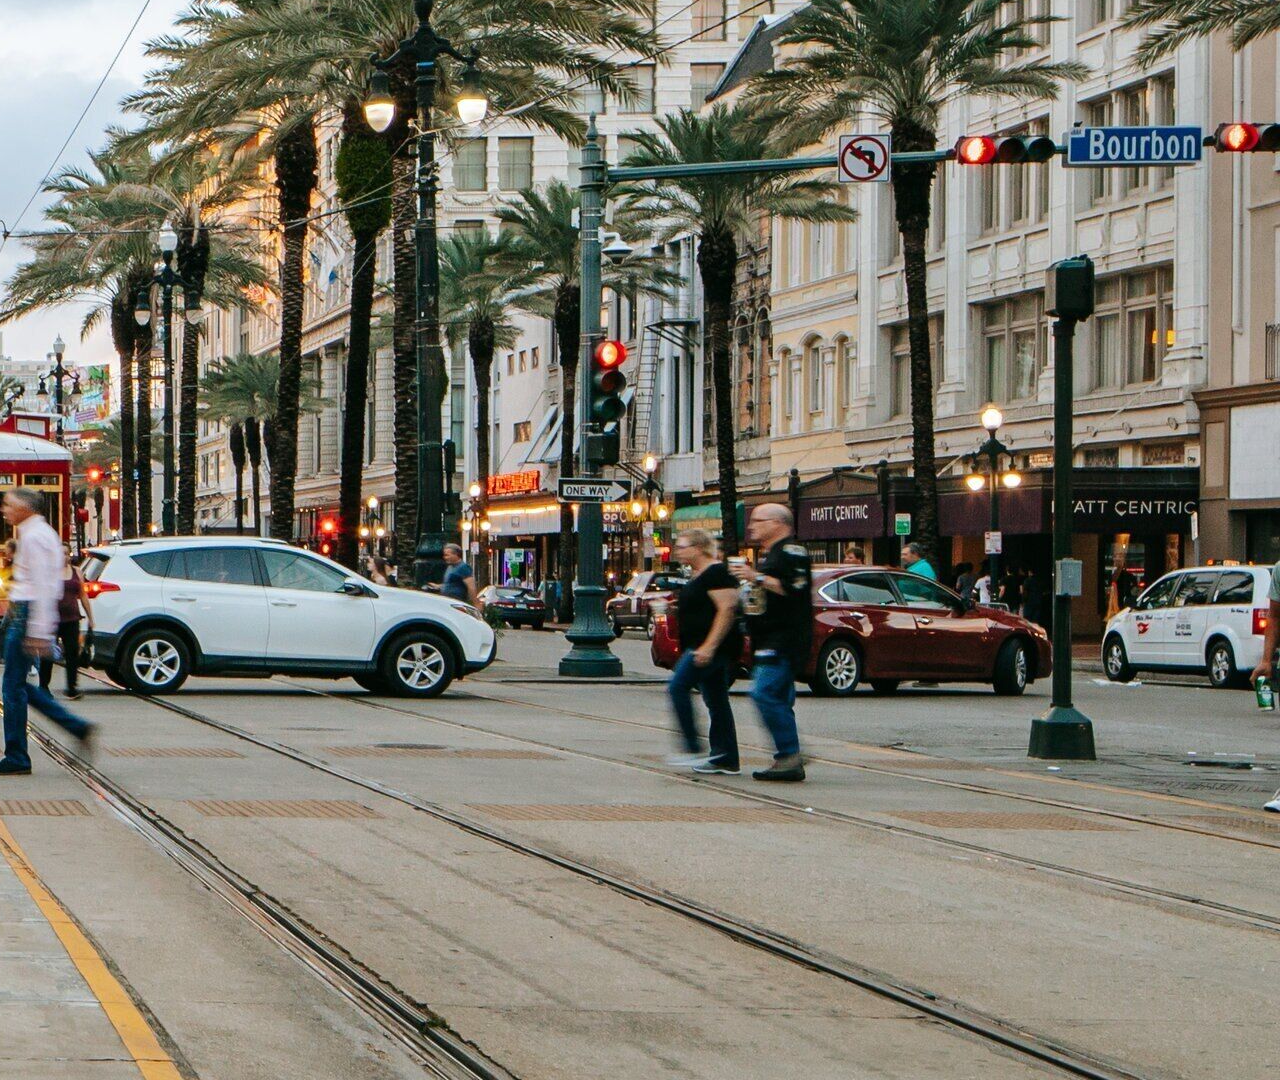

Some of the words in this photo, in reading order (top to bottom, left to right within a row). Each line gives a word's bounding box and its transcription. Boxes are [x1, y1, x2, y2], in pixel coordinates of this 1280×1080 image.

[1089, 129, 1196, 160] Bourbon
[565, 486, 586, 496] ONE
[589, 486, 610, 496] WAY
[811, 506, 834, 522] HYATT
[834, 504, 868, 522] CENTRIC
[1051, 500, 1108, 514] ATT
[1114, 500, 1196, 517] CENTRIC
